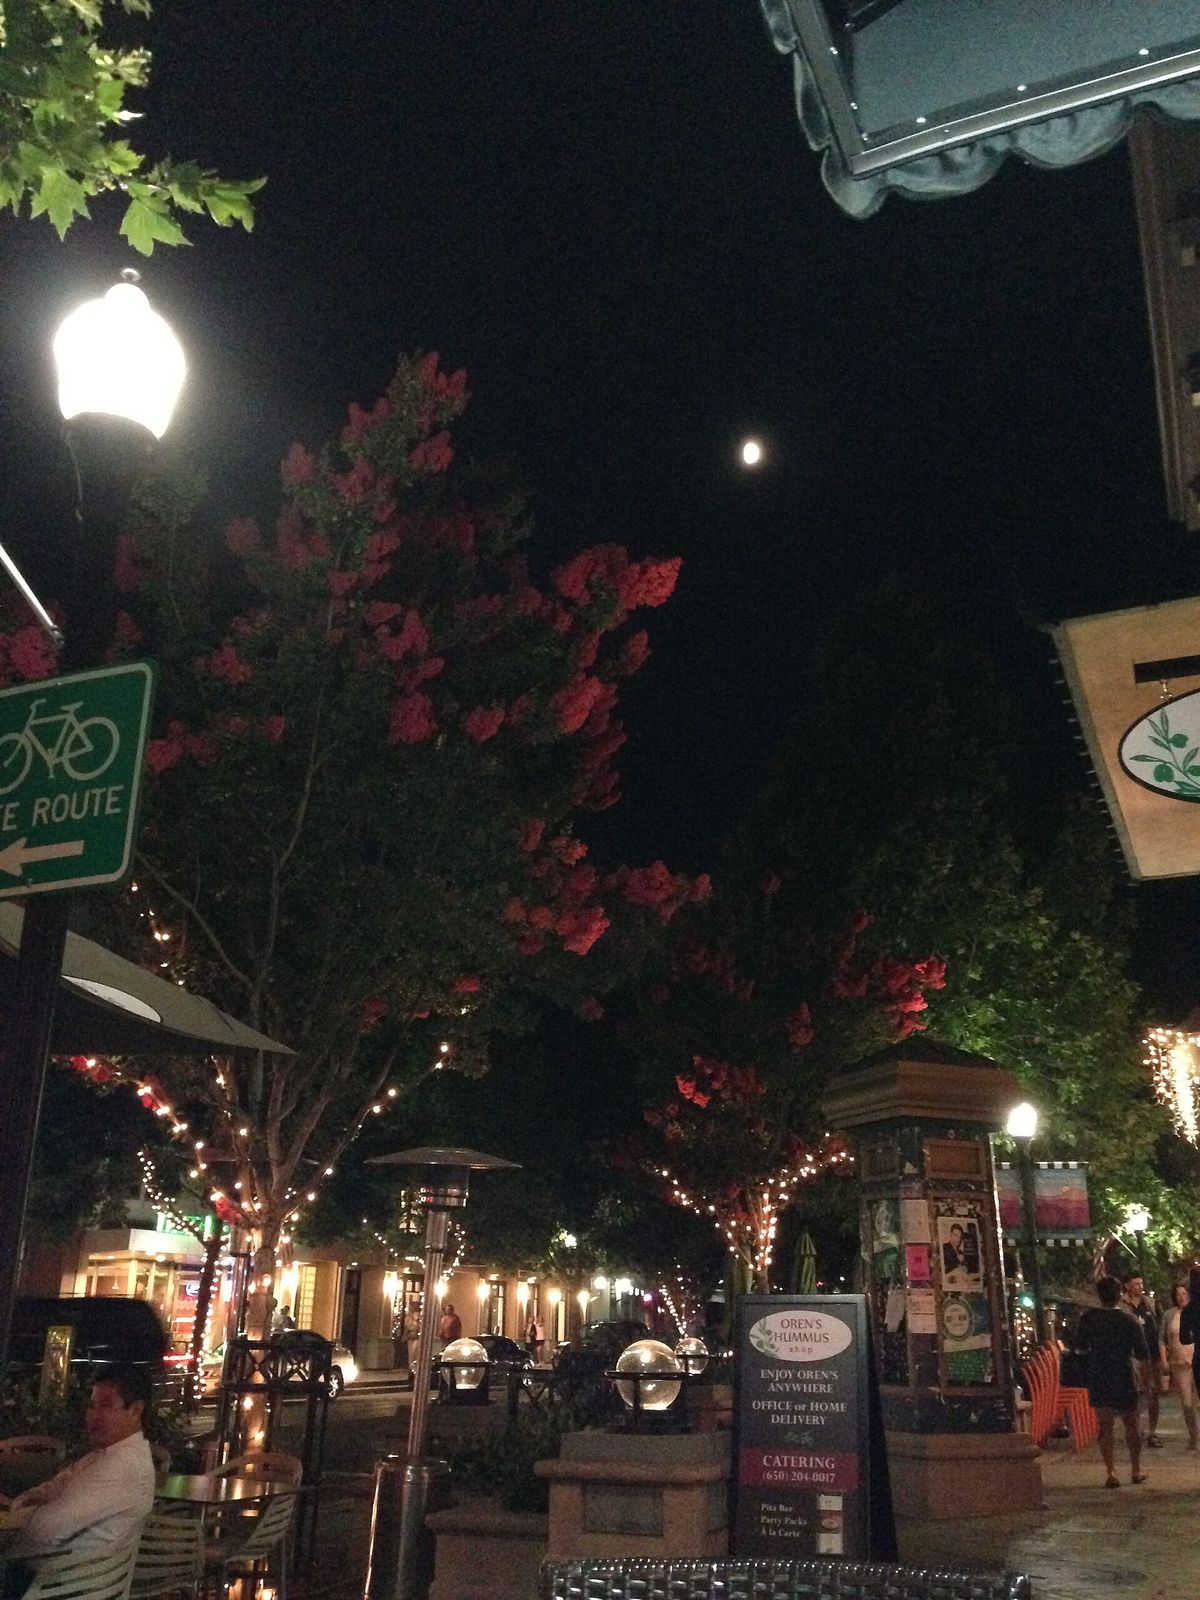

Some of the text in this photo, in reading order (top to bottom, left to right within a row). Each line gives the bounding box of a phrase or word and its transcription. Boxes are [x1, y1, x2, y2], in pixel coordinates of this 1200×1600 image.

[31, 785, 124, 827] ROUTE
[780, 1318, 823, 1329] OREN'S
[774, 1332, 830, 1343] HUMMUS
[789, 1346, 813, 1355] shop
[760, 1369, 839, 1381] ENJOY OREN'S
[768, 1383, 833, 1393] ANYWHERE
[752, 1401, 792, 1411] OFFICE
[810, 1402, 847, 1413] HOME
[771, 1414, 826, 1425] DELIVERY
[763, 1455, 835, 1469] CATERING
[762, 1471, 836, 1483] (650) 204-0017
